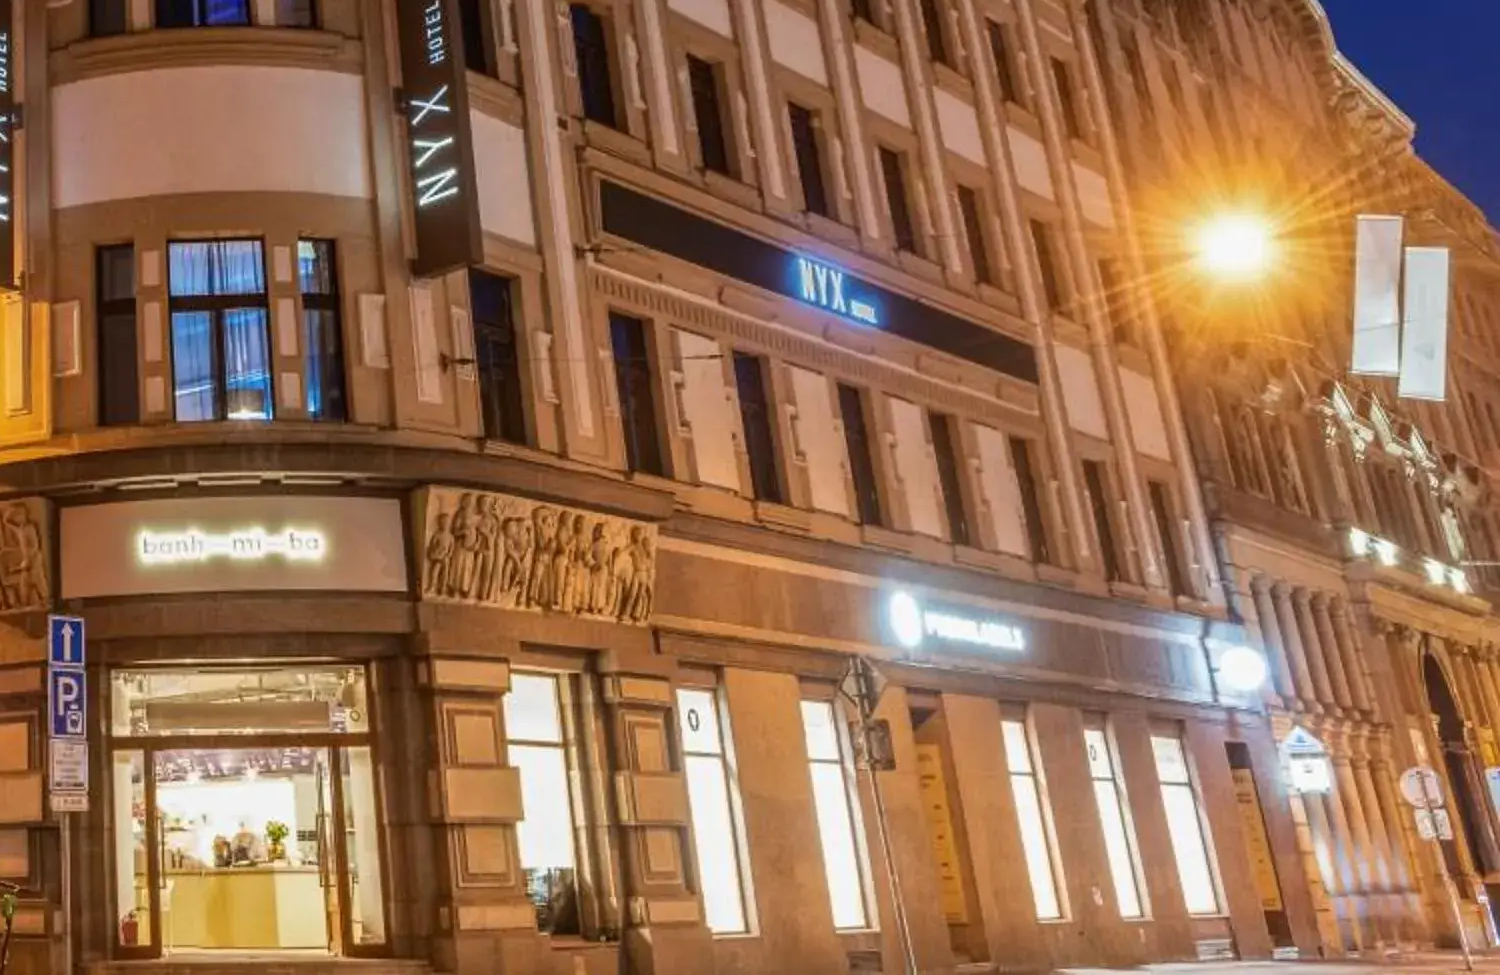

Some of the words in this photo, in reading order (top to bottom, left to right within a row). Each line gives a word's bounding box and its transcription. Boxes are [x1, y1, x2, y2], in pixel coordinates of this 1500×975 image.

[410, 84, 458, 207] NYX
[798, 257, 848, 314] NYX
[57, 676, 79, 716] P
